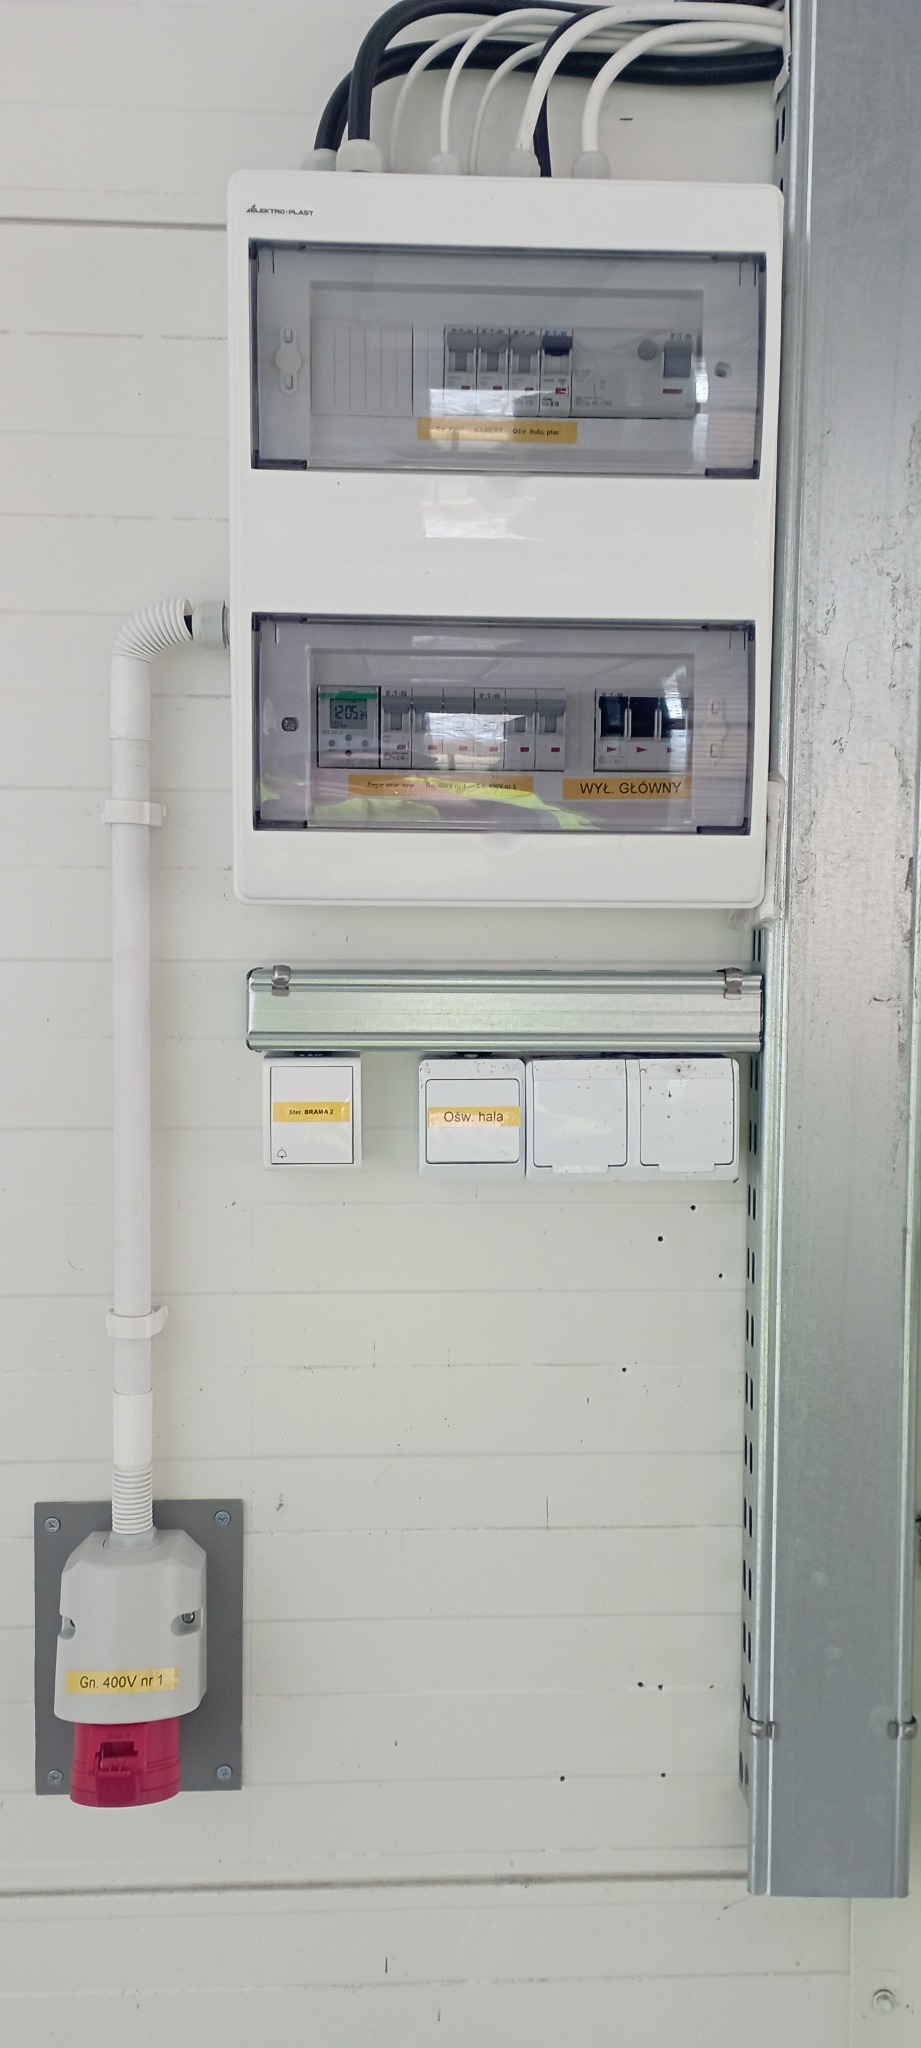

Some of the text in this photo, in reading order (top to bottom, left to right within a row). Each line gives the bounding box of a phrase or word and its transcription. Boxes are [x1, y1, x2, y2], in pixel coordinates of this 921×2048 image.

[580, 781, 681, 794] WYŁ. GŁÓWNY
[443, 1110, 504, 1122] Ośw. hala
[79, 1673, 163, 1689] Gn. 400V nr 1
